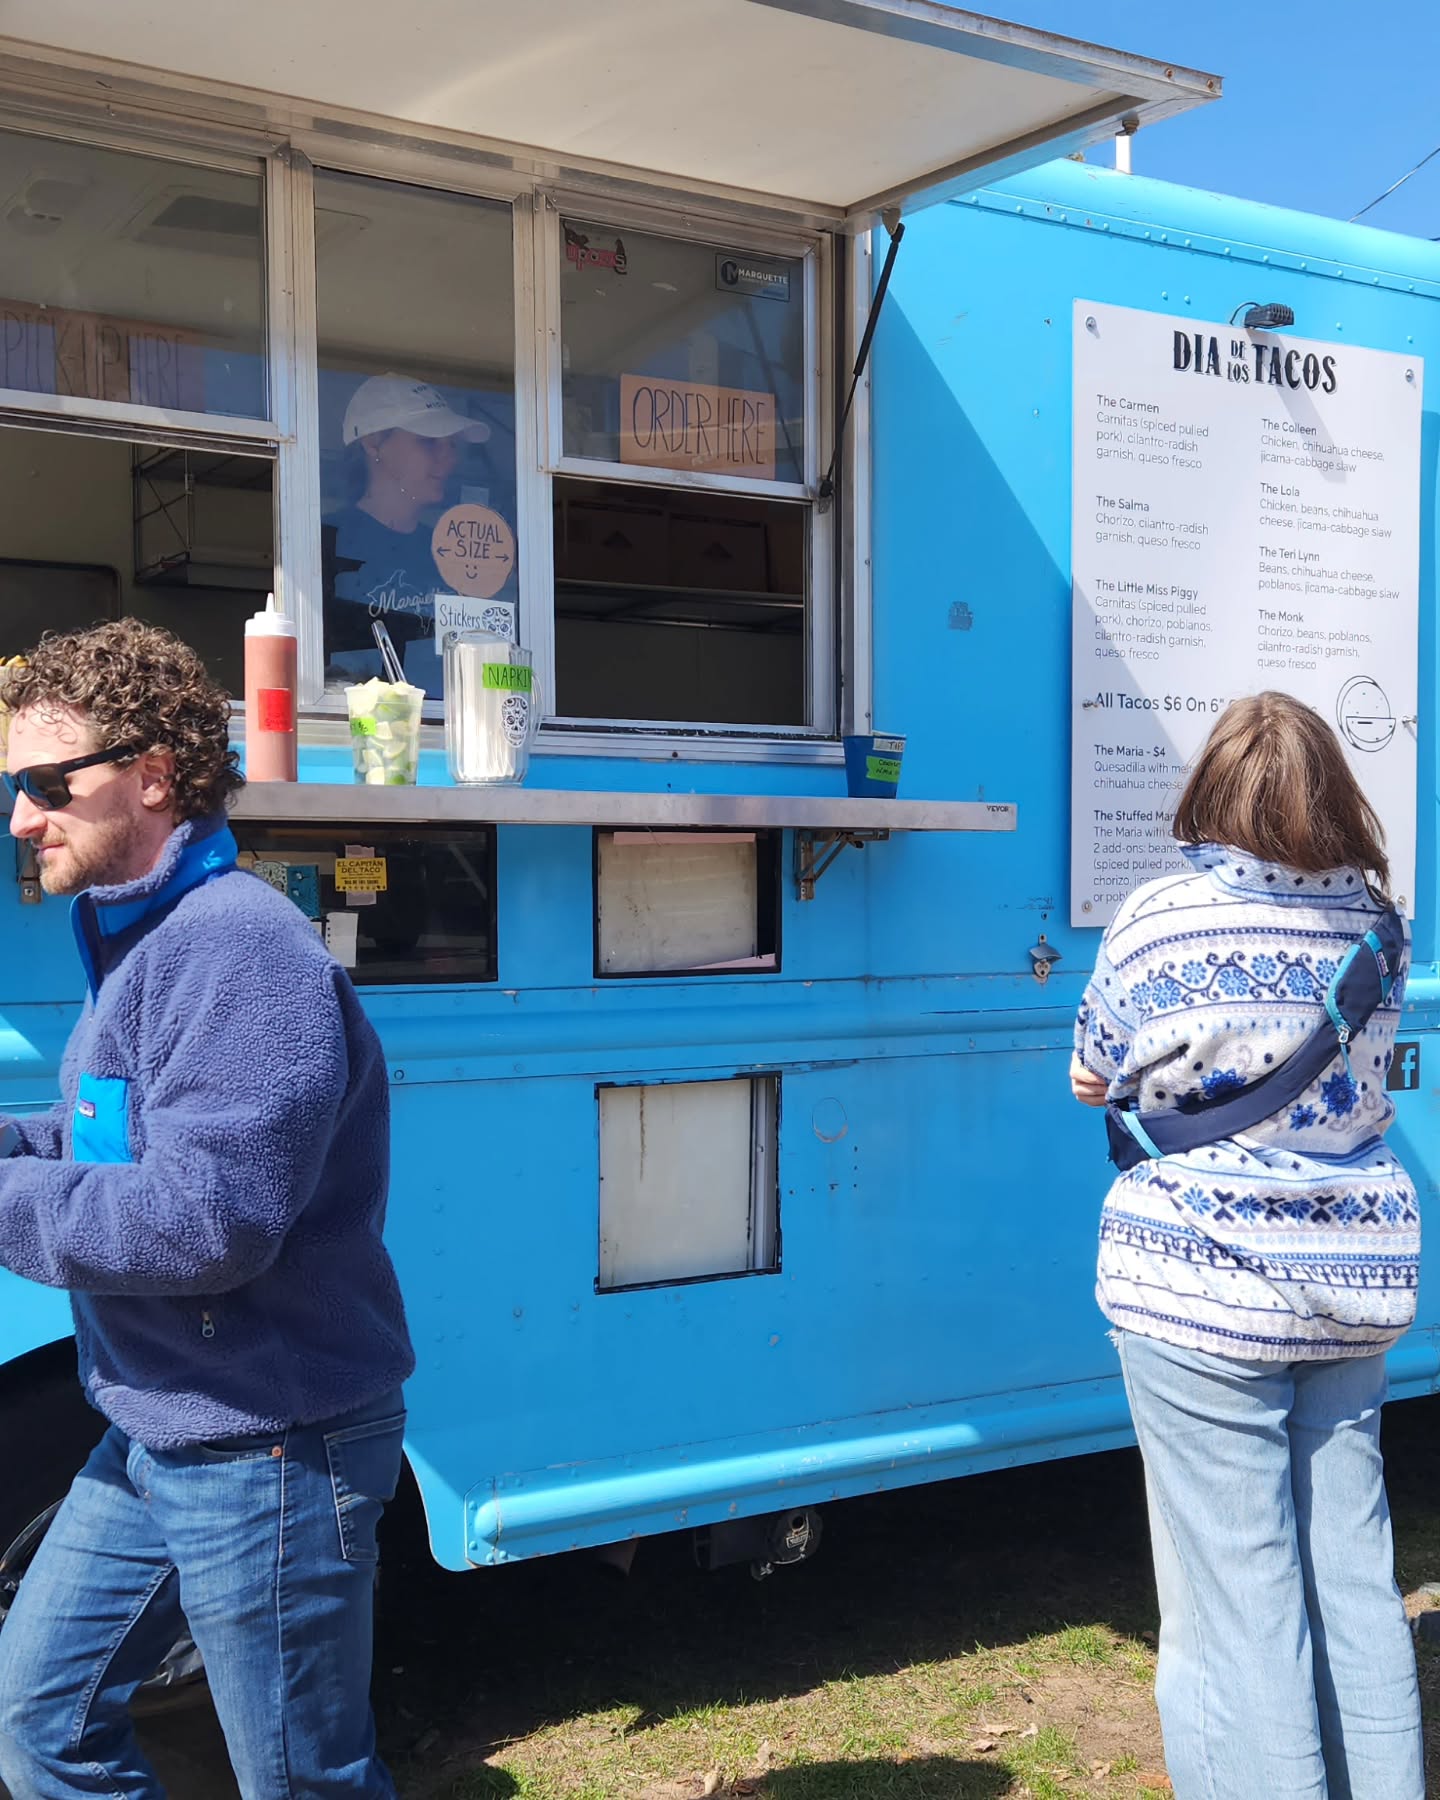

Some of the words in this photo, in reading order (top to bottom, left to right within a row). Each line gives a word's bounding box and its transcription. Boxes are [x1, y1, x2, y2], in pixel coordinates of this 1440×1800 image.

[738, 268, 788, 285] MARQUETTE
[1173, 330, 1222, 377] DIA
[1231, 340, 1247, 360] DE
[1227, 361, 1250, 384] LOS
[1251, 343, 1338, 394] TACOS
[1096, 394, 1117, 408] The
[1119, 398, 1160, 414] Carmen
[633, 386, 712, 456] ORDER
[717, 397, 766, 464] HERE
[1096, 411, 1138, 427] Carnitas
[1140, 417, 1177, 432] (spiced
[1179, 424, 1209, 437] pulled
[1261, 418, 1280, 430] The
[1282, 421, 1317, 436] Colleen
[1127, 432, 1198, 452] cilantro-radish
[1302, 441, 1349, 456] chihuahua
[1138, 453, 1170, 465] queso
[1171, 454, 1202, 469] fresco
[1260, 450, 1334, 472] jicama-cabbage
[1336, 460, 1357, 472] slaw
[1260, 482, 1279, 495] The
[1280, 484, 1300, 497] Lola
[1095, 495, 1116, 508] The
[1118, 498, 1150, 512] Salma
[1301, 503, 1331, 517] beans,
[1332, 506, 1379, 521] chihuahua
[447, 520, 504, 543] ACTUAL
[1138, 517, 1209, 535] cilantro-radish
[1297, 518, 1370, 538] jicama-cabbage
[1371, 527, 1392, 538] slaw
[454, 539, 490, 559] SIZE
[1137, 535, 1168, 548] queso
[1171, 536, 1201, 550] fresco
[1259, 545, 1277, 558] The
[1279, 548, 1297, 560] Teri
[1298, 549, 1320, 563] Lynn
[1291, 564, 1339, 579] chihuahua
[1095, 579, 1116, 591] The
[1117, 581, 1143, 594] Little
[1146, 583, 1168, 596] Miss
[1170, 585, 1199, 601] Piggy
[1304, 581, 1378, 600] jicama-cabbage
[1379, 588, 1400, 600] slaw
[368, 587, 441, 617] Marquet
[1095, 595, 1136, 610] Carnitas
[1138, 598, 1174, 613] (spiced
[1176, 602, 1207, 616] pulled
[439, 603, 481, 629] Stickers
[1125, 615, 1164, 629] chorizo,
[1166, 618, 1213, 632] poblanos,
[1258, 608, 1276, 621] The
[1278, 610, 1304, 623] Monk
[1095, 629, 1167, 645] cilantro-radish
[1168, 635, 1206, 648] garnish,
[1328, 630, 1373, 644] poblanos,
[1094, 647, 1126, 659] queso
[1128, 647, 1160, 661] fresco
[1257, 640, 1323, 656] cilantro-radish
[1324, 645, 1360, 659] garnish,
[1257, 657, 1286, 670] queso
[1288, 658, 1317, 671] fresco
[1096, 692, 1114, 708] All
[1117, 693, 1160, 710] Tacos
[1163, 694, 1182, 712] $6
[1186, 697, 1206, 712] On
[1210, 698, 1224, 713] 6"
[1094, 744, 1114, 756] The
[1116, 745, 1144, 757] Maria
[1153, 746, 1166, 758] $4
[1094, 761, 1146, 773] Quesadilla
[1148, 762, 1169, 774] with
[1093, 777, 1145, 789] chihuahua
[1147, 778, 1184, 790] cheese
[986, 804, 1009, 812] VEVOR
[1093, 809, 1113, 821] The
[1115, 810, 1152, 821] Stuffed
[1155, 811, 1175, 821] Mar
[1093, 826, 1113, 837] The
[1115, 826, 1142, 837] Maria
[1144, 826, 1166, 837] with
[1093, 842, 1100, 853] 2
[1102, 842, 1145, 853] add-ons:
[1093, 859, 1129, 872] (spiced
[1132, 859, 1162, 872] pulled
[1093, 874, 1132, 887] chorizo,
[1093, 893, 1104, 902] or
